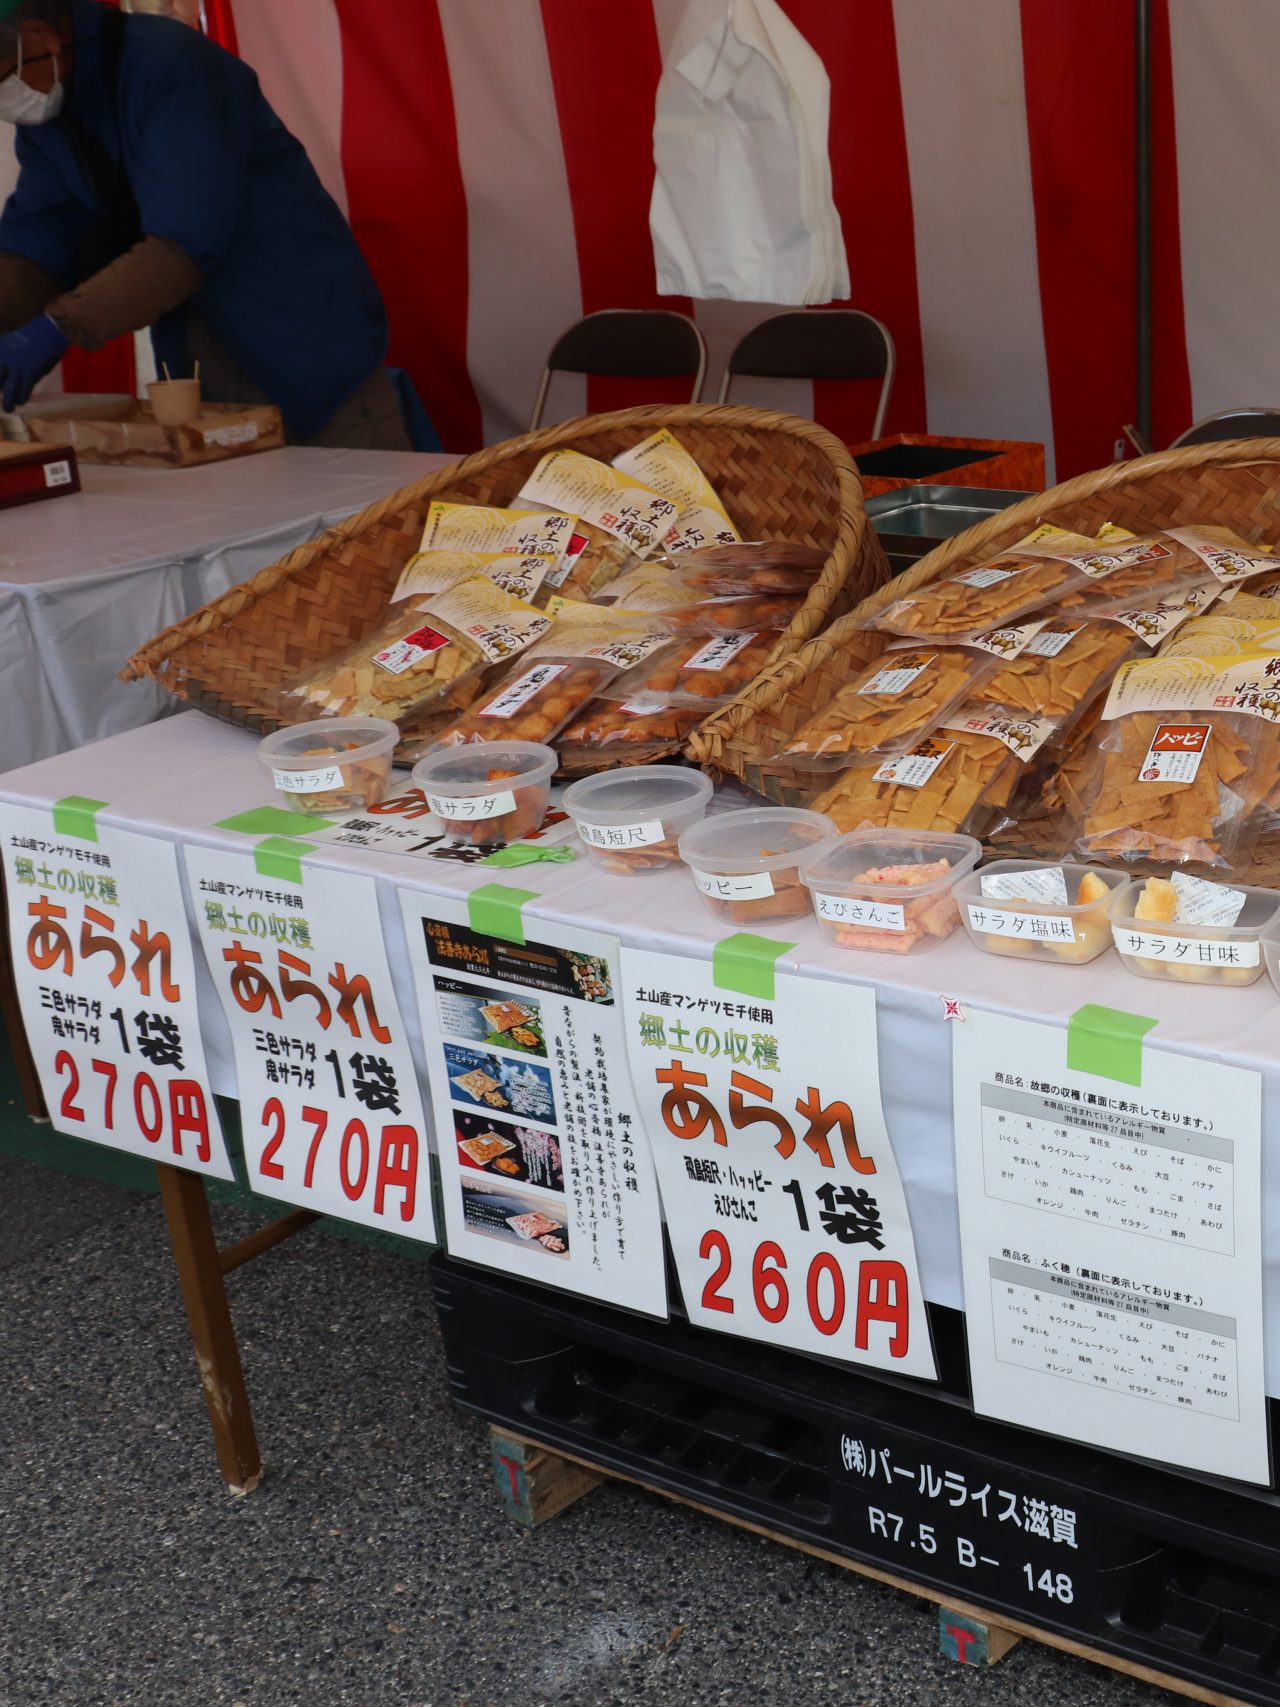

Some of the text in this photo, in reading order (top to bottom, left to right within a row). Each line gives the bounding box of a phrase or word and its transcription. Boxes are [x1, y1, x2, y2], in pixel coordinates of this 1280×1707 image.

[639, 499, 676, 534] 郷土の
[1234, 682, 1260, 709] 収穫
[1155, 731, 1203, 747] ハッピー
[10, 835, 111, 868] 土山産マンゲツモチ使用
[14, 856, 120, 906] 郷土の収穫
[199, 878, 303, 910] 土山産マンゲツモチ使用
[700, 880, 753, 895] ッピー
[204, 900, 314, 950] 郷土の収穫
[819, 900, 900, 925] えびさんご
[971, 911, 1072, 939] サラダ塩味
[26, 895, 180, 1003] あられ
[1127, 935, 1240, 964] サラダ甘味
[38, 986, 102, 1020] 三色サラダ
[222, 940, 392, 1045] あられ
[636, 988, 774, 1025] 土山産マンゲツモチ使用
[51, 1015, 101, 1045] 鬼サラダ
[110, 1009, 187, 1071] 1袋
[252, 1028, 317, 1062] 三色サラダ
[639, 1012, 781, 1072] 郷土の収穫
[266, 1058, 315, 1090] 鬼サラダ
[325, 1049, 402, 1115] 1袋
[55, 1049, 211, 1162] 270円
[655, 1059, 877, 1175] あられ
[260, 1096, 418, 1222] 270円
[618, 1112, 640, 1193] 郷土の収穫
[999, 1134, 1215, 1191] いくら キウイフルーツ くるみ 大豆 バナナ
[1026, 1122, 1033, 1130] 乳
[1054, 1128, 1068, 1138] 小麦
[1089, 1136, 1111, 1149] 落花生
[1133, 1147, 1148, 1157] えび
[1170, 1156, 1185, 1166] そば
[1208, 1164, 1222, 1174] かに
[1000, 1170, 1223, 1230] さけ いか 鶏肉 りんご まつたけ あわび
[1013, 1156, 1222, 1212] やまいも カシューナッツ もも ごま さば
[782, 1180, 886, 1251] 1袋
[1036, 1197, 1186, 1239] オレンジ 牛肉 ゼラチン 豚肉
[700, 1229, 909, 1358] 260円
[1008, 1305, 1219, 1364] いくら キウイフルーツ くるみ 大豆 バナナ
[1061, 1301, 1075, 1312] 小麦
[1096, 1310, 1118, 1322] 落花生
[1138, 1321, 1153, 1330] えび
[1174, 1330, 1189, 1340] そば
[1211, 1339, 1226, 1348] かに
[1011, 1337, 1229, 1398] さけ いか 鶏肉 りんご まつたけ あわび
[1022, 1325, 1227, 1382] やまいも カシューナッツ もも ごま さば
[1045, 1362, 1193, 1406] オレンジ 牛肉 ゼラチン 豚肉
[868, 1505, 937, 1555] R7.5
[1023, 1562, 1074, 1605] 148
